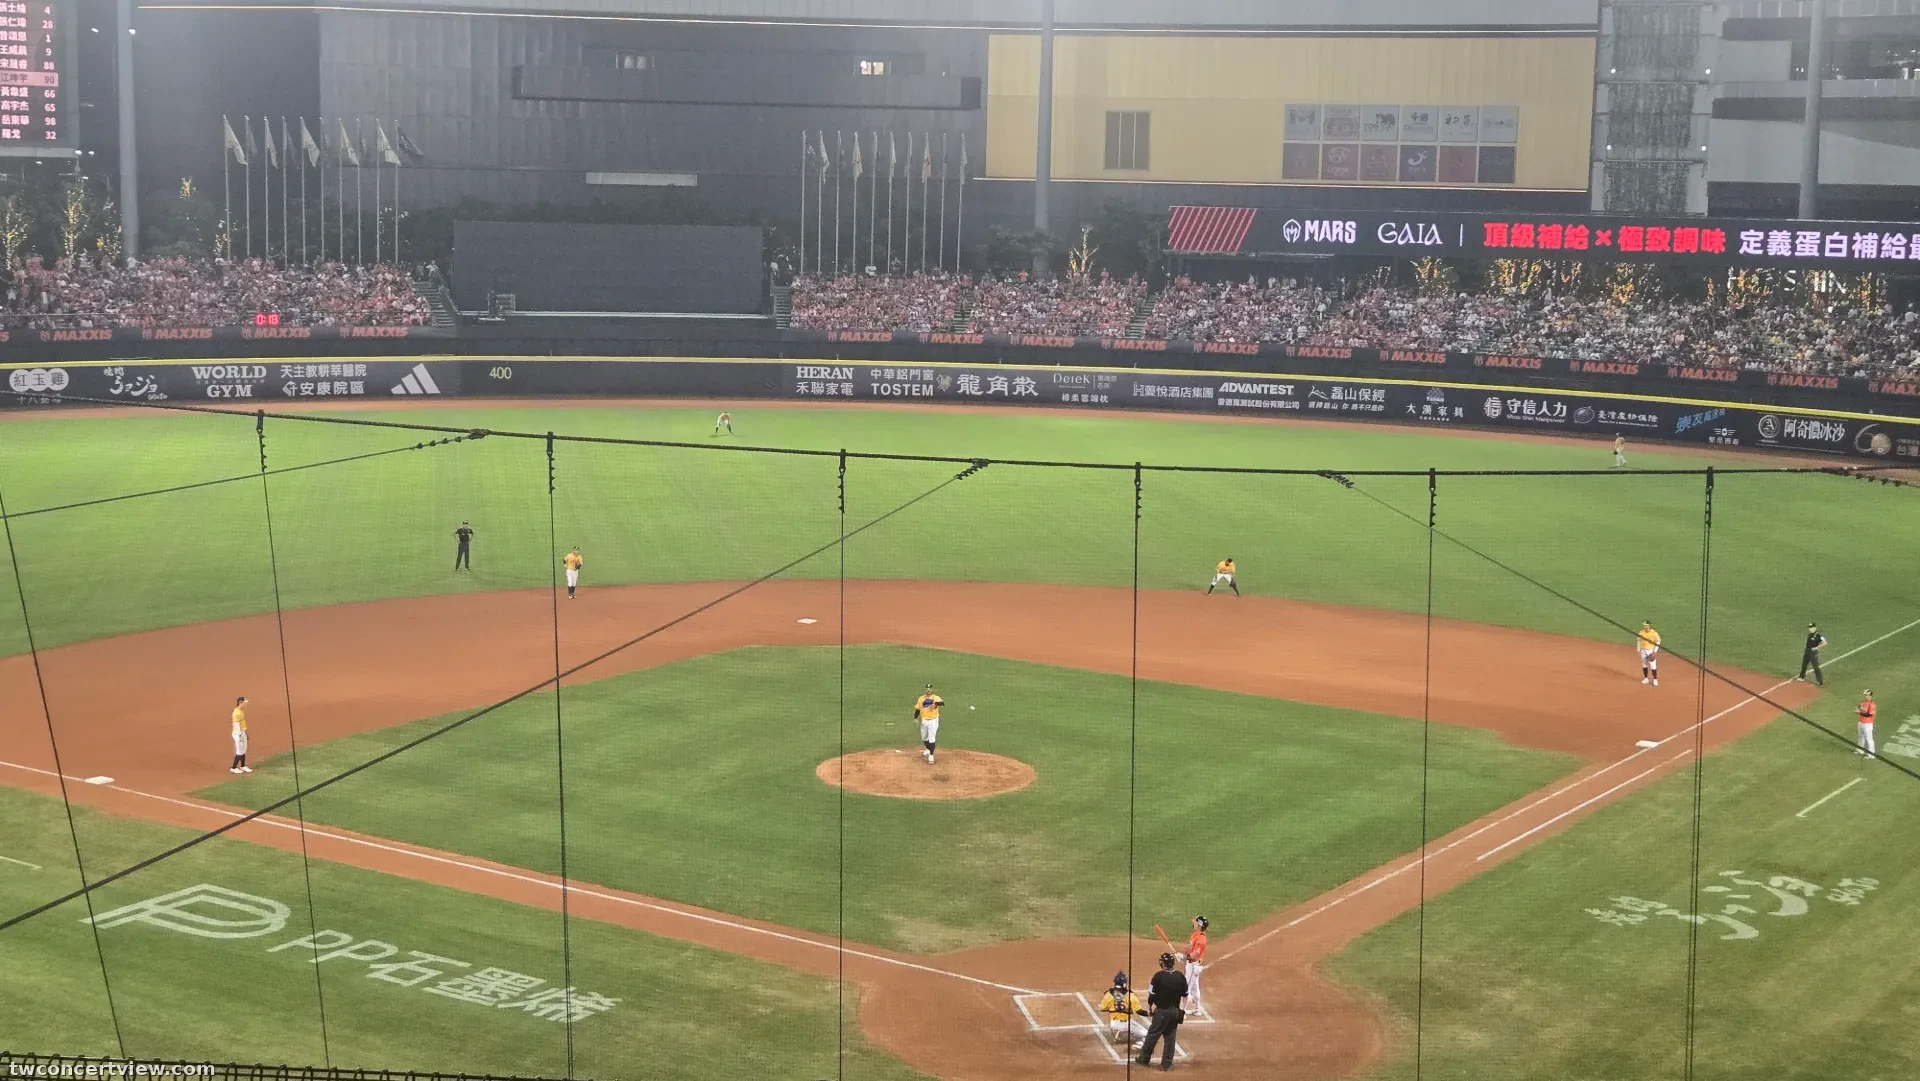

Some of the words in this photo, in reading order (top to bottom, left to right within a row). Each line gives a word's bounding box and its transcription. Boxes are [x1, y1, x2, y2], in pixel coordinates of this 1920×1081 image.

[44, 6, 51, 15] 4
[42, 20, 54, 29] 28
[45, 34, 52, 43] 1
[45, 47, 52, 57] 9
[43, 61, 55, 71] 88
[44, 75, 55, 84] 90
[44, 89, 56, 99] 66
[44, 102, 56, 112] 65
[44, 116, 56, 126] 98
[45, 130, 57, 140] 32
[1304, 220, 1357, 243] MARS
[1377, 222, 1443, 246] GAIA
[1483, 222, 1590, 250] 頂級補給
[1618, 225, 1727, 254] 極致調味
[352, 326, 408, 338] MAXXIS
[1204, 343, 1259, 355] MAXXIS
[1298, 346, 1353, 359] MAXXIS
[1391, 350, 1446, 364] MAXXIS
[1486, 354, 1541, 369] MAXXIS
[191, 365, 267, 380] WORLD
[280, 364, 367, 379] 天主教耕莘醫院
[489, 367, 512, 380] 400
[796, 366, 854, 380] HERAN
[870, 368, 935, 382] 中華鋁門窗
[1583, 361, 1639, 375] MAXXIS
[1681, 366, 1737, 381] MAXXIS
[206, 384, 253, 398] GYM
[300, 380, 365, 396] 安康院區
[796, 381, 854, 397] 禾聯家電
[870, 383, 935, 397] TOSTEM
[956, 373, 1040, 397] 龍角散
[1219, 381, 1294, 396] ADVANTEST
[1330, 387, 1386, 403] 磊山保經
[1506, 398, 1567, 418] 守信人力
